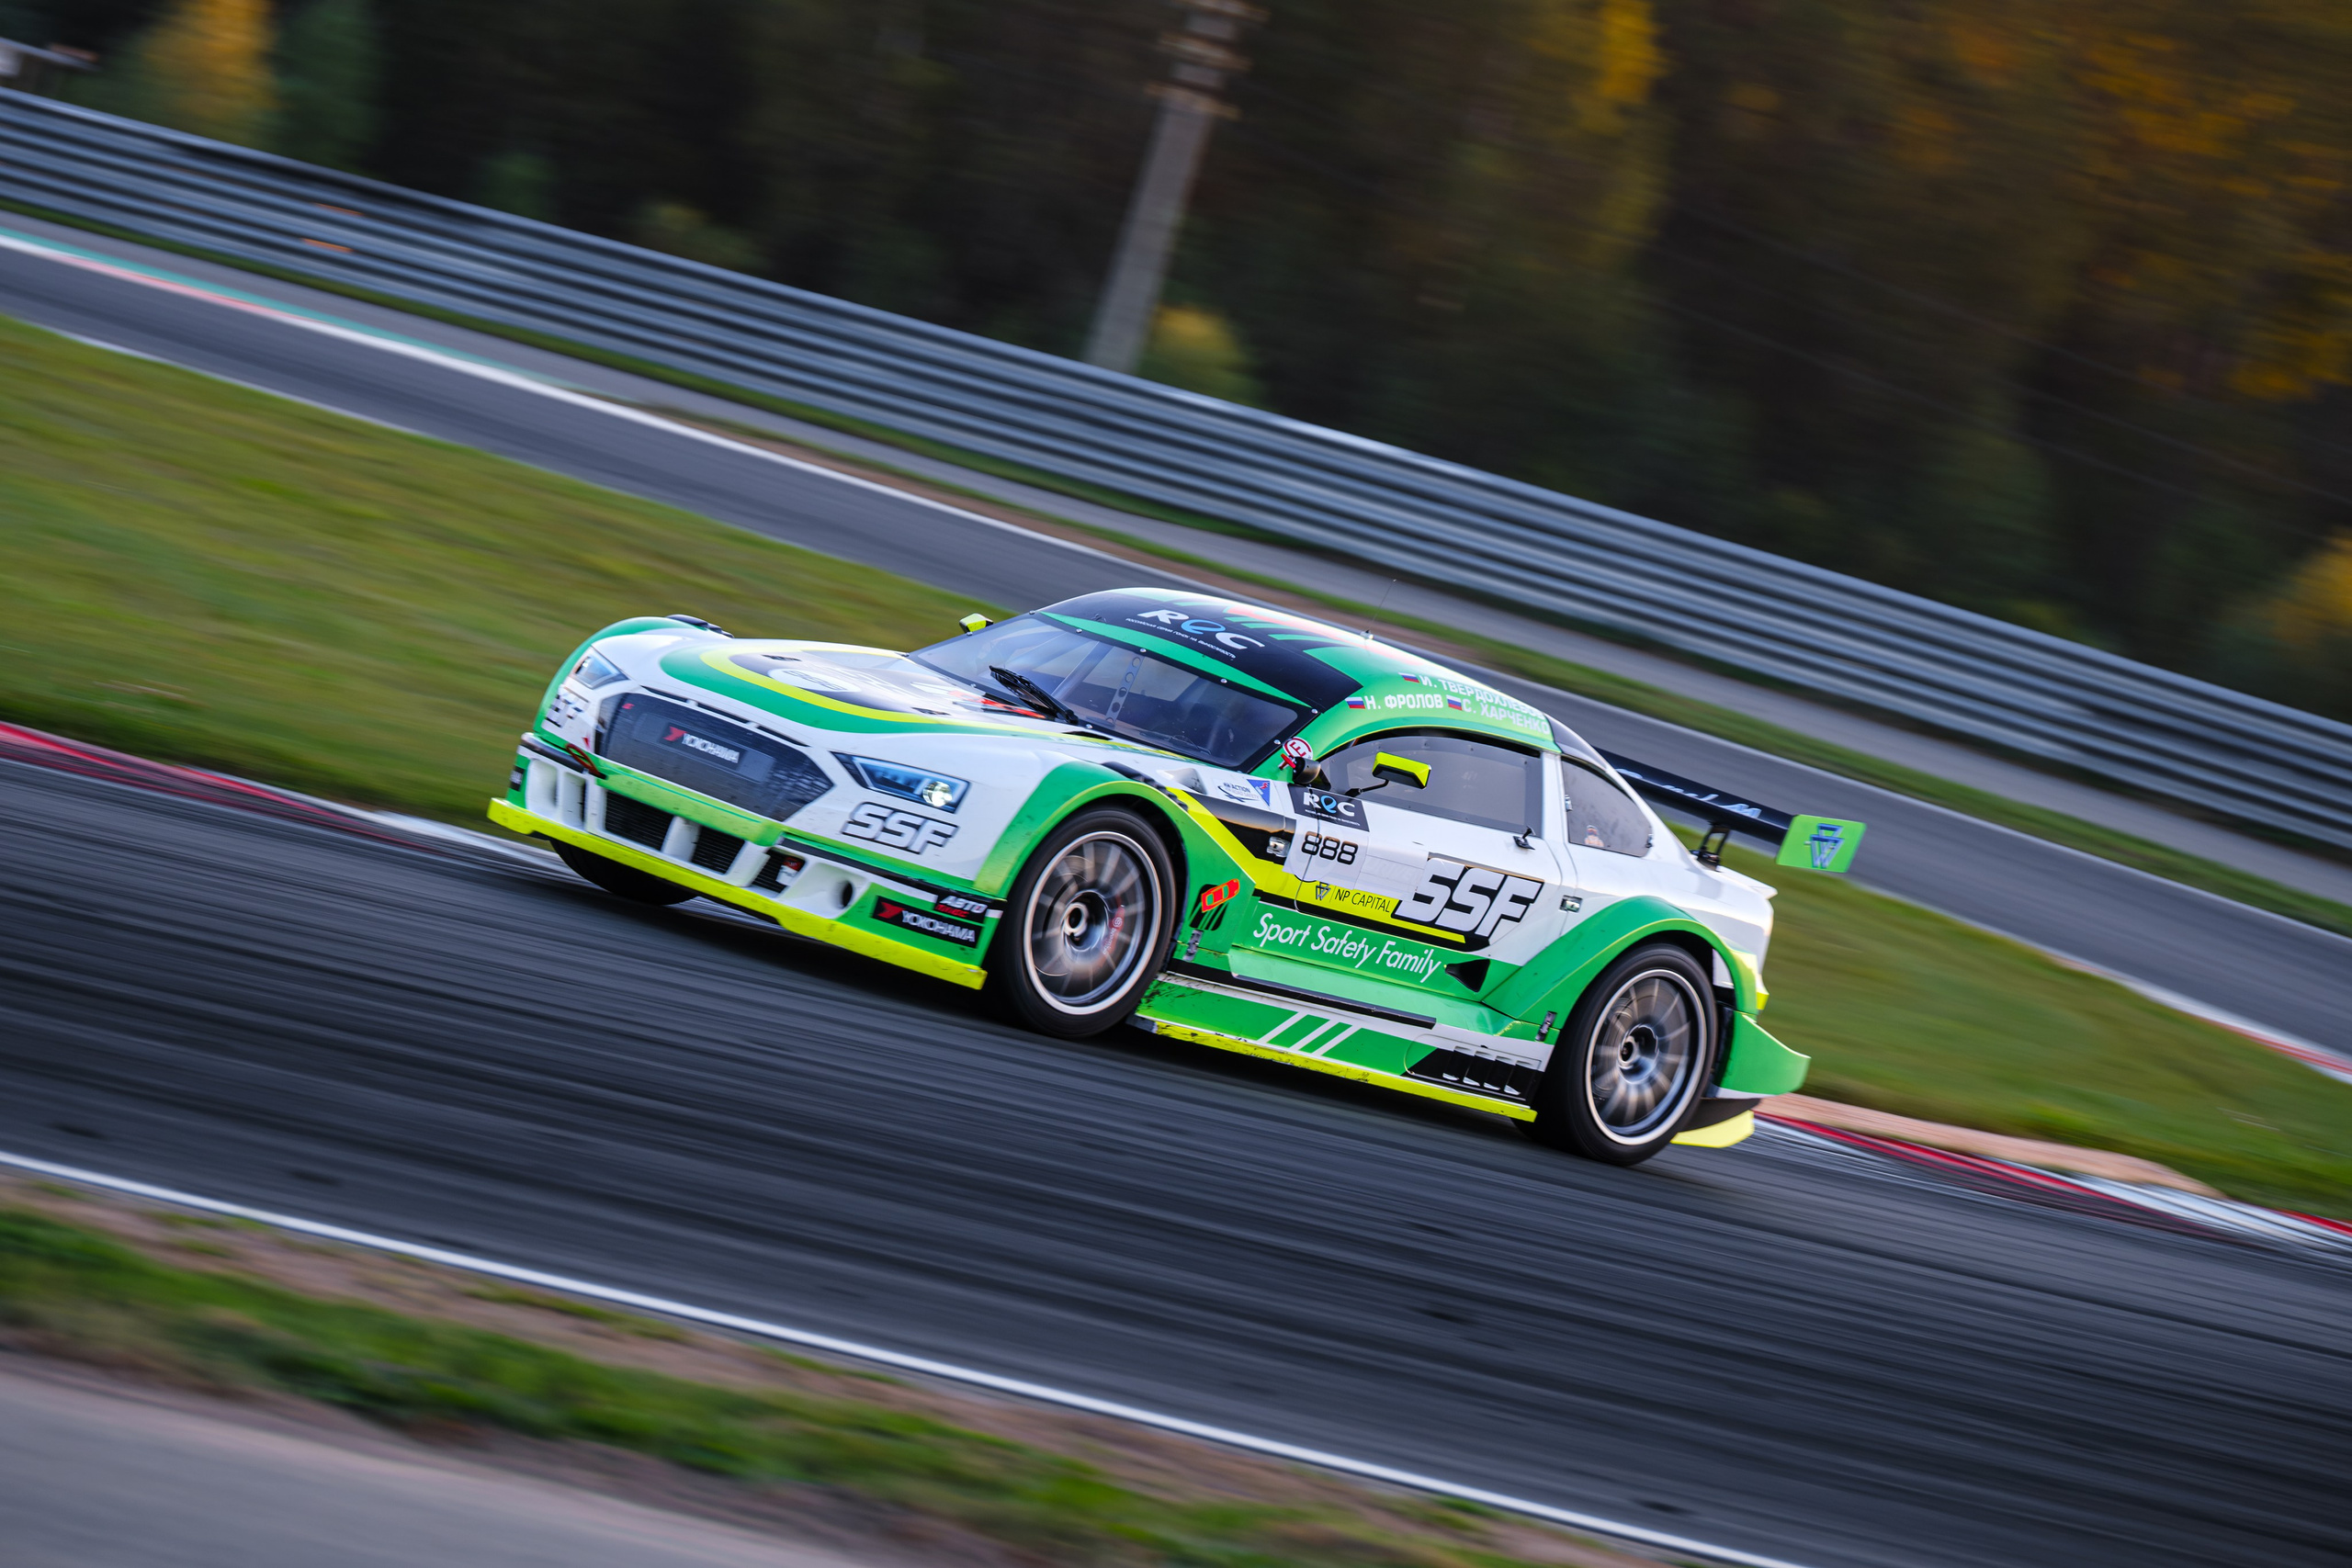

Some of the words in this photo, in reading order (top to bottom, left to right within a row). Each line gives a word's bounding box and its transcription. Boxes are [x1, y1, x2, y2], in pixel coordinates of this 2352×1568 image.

[1364, 695, 1381, 710] Н.
[1385, 694, 1444, 709] ФРОЛОВ
[1462, 697, 1476, 714] С.
[1480, 703, 1551, 735] ХАРЧЕНКО
[682, 732, 741, 763] YOKOHAMA
[841, 801, 961, 855] SSF
[1301, 830, 1359, 865] 888
[1335, 888, 1351, 904] NP
[1351, 891, 1391, 913] CAPITAL
[1392, 857, 1544, 938] SSF
[901, 910, 976, 942] YOKOHAMA
[1252, 912, 1312, 948] Sport
[1310, 925, 1377, 968] Safety
[1375, 940, 1442, 983] Family
